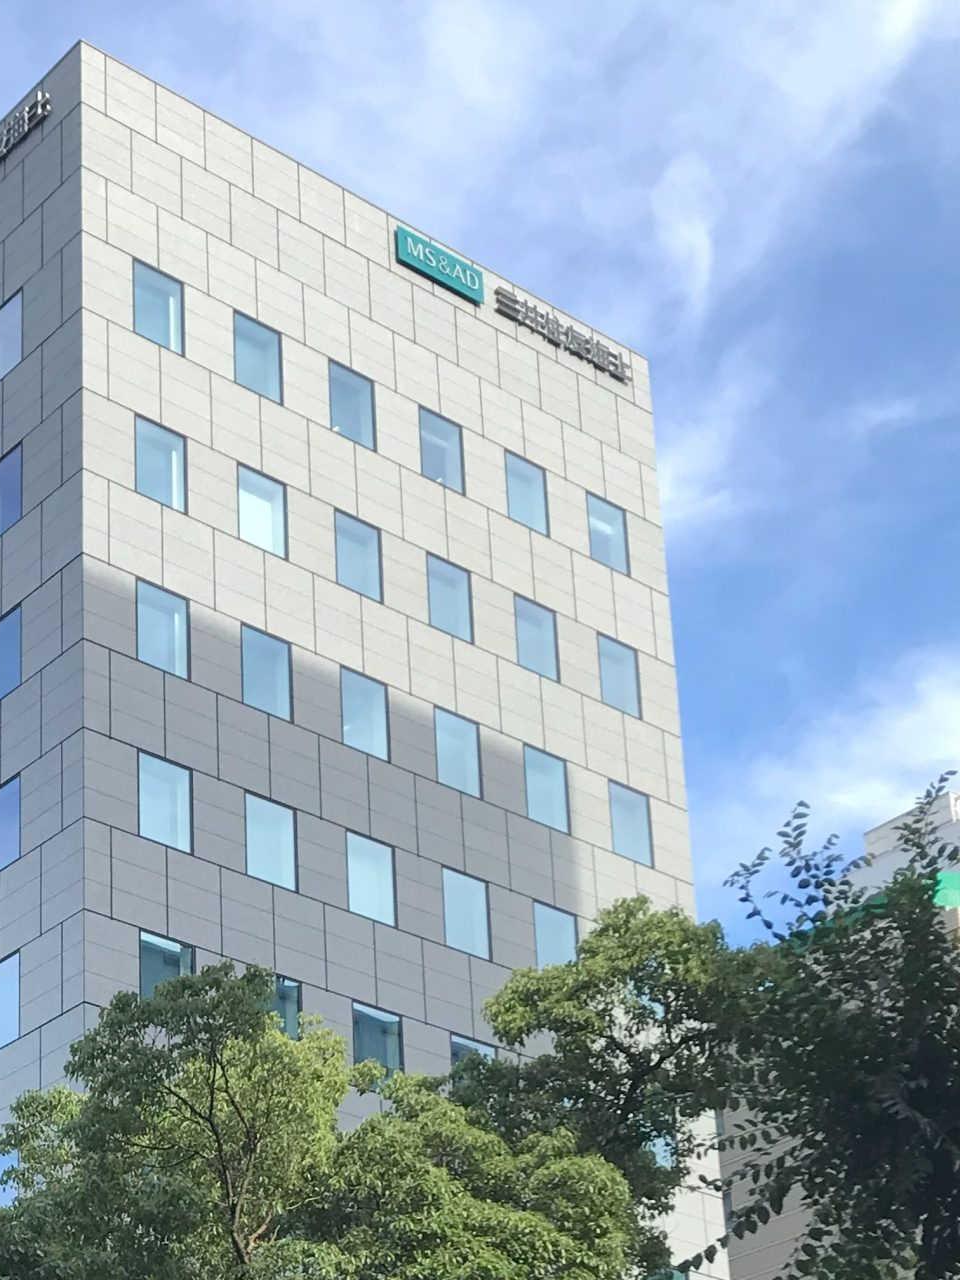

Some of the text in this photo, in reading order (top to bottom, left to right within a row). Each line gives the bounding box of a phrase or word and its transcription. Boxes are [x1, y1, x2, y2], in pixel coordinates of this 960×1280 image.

[406, 236, 479, 290] MS&AD
[494, 285, 632, 384] 三井住友海上
